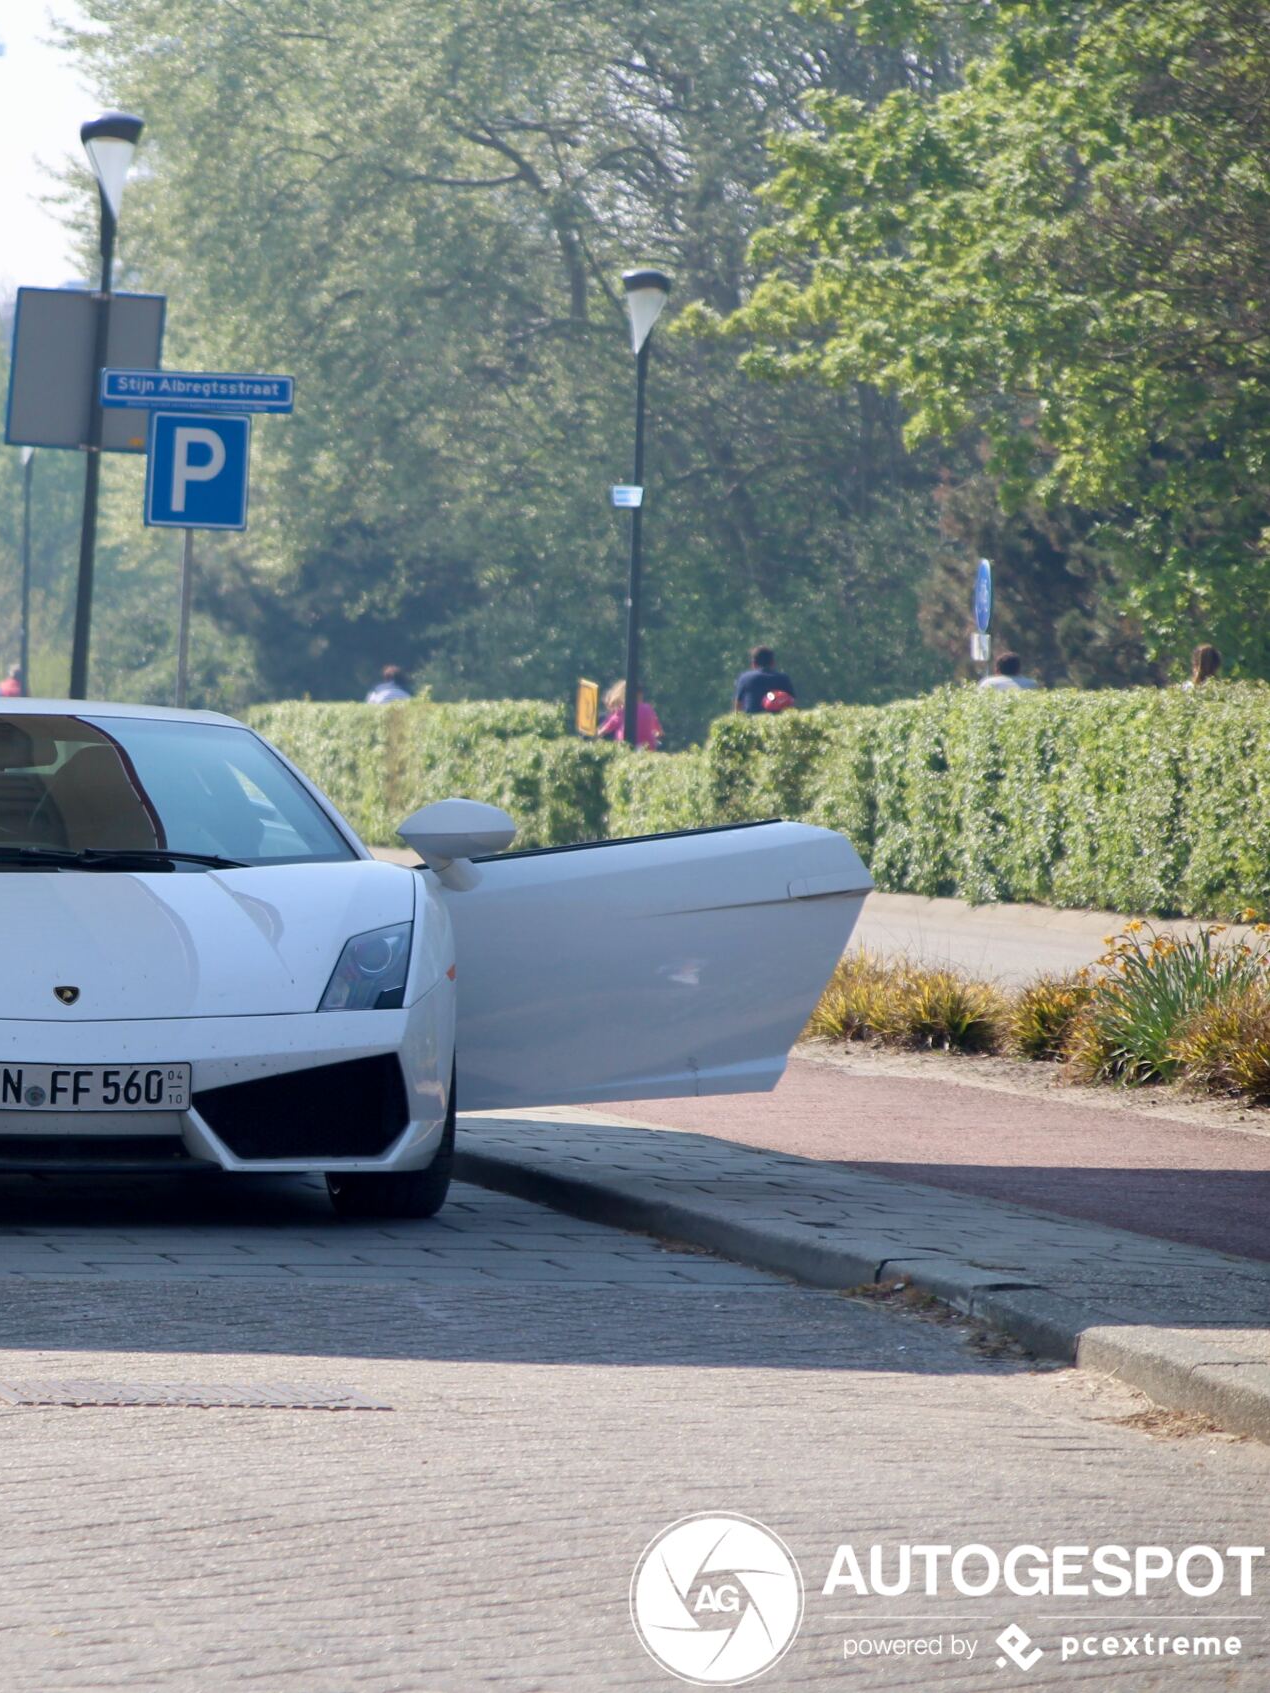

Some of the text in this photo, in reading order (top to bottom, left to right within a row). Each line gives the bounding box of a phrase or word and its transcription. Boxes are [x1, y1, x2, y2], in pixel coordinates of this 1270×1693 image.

[117, 376, 280, 397] Stijn Albregtsstraat
[170, 426, 226, 512] P
[167, 1070, 183, 1081] 04
[50, 1070, 93, 1105] FF
[102, 1069, 163, 1105] 560
[168, 1094, 183, 1104] 10
